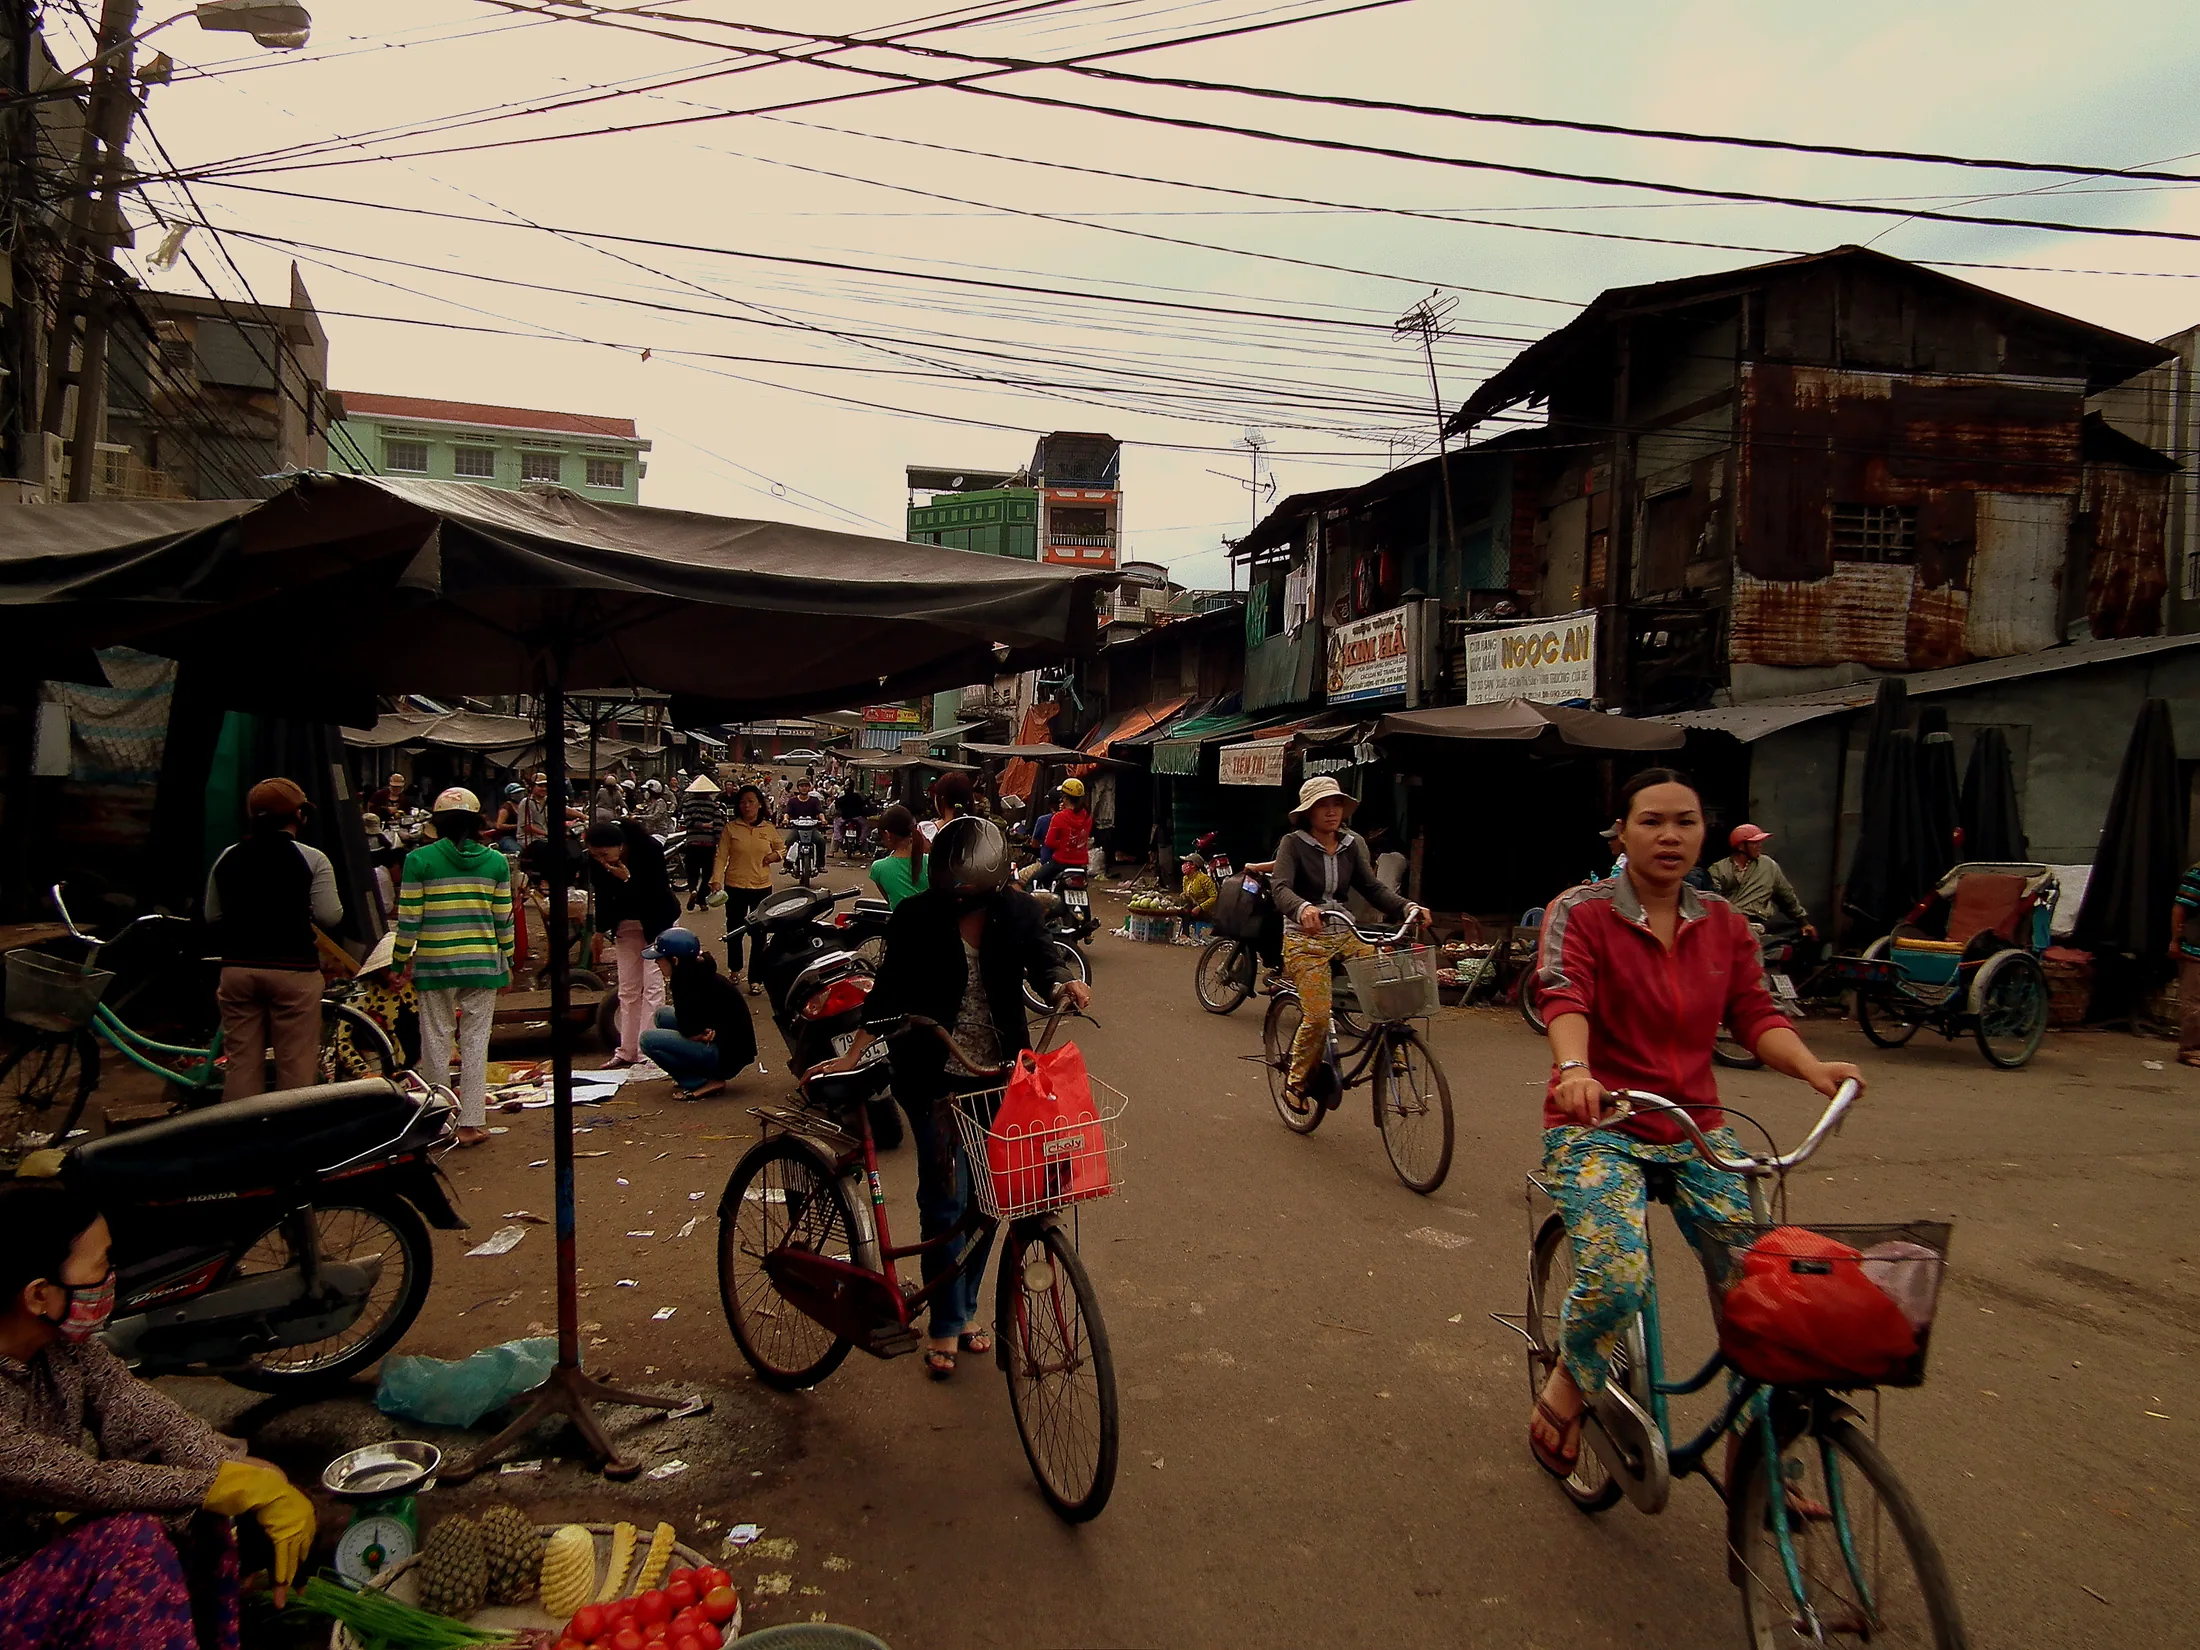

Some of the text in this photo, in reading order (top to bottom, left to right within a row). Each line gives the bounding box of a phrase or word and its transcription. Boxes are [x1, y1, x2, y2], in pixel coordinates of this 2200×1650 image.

[1343, 636, 1376, 668] KIM
[1501, 624, 1589, 670] NGỌC AN
[1047, 1139, 1081, 1154] Chaly
[186, 1190, 238, 1203] HONDA
[126, 1283, 192, 1305] Dream
